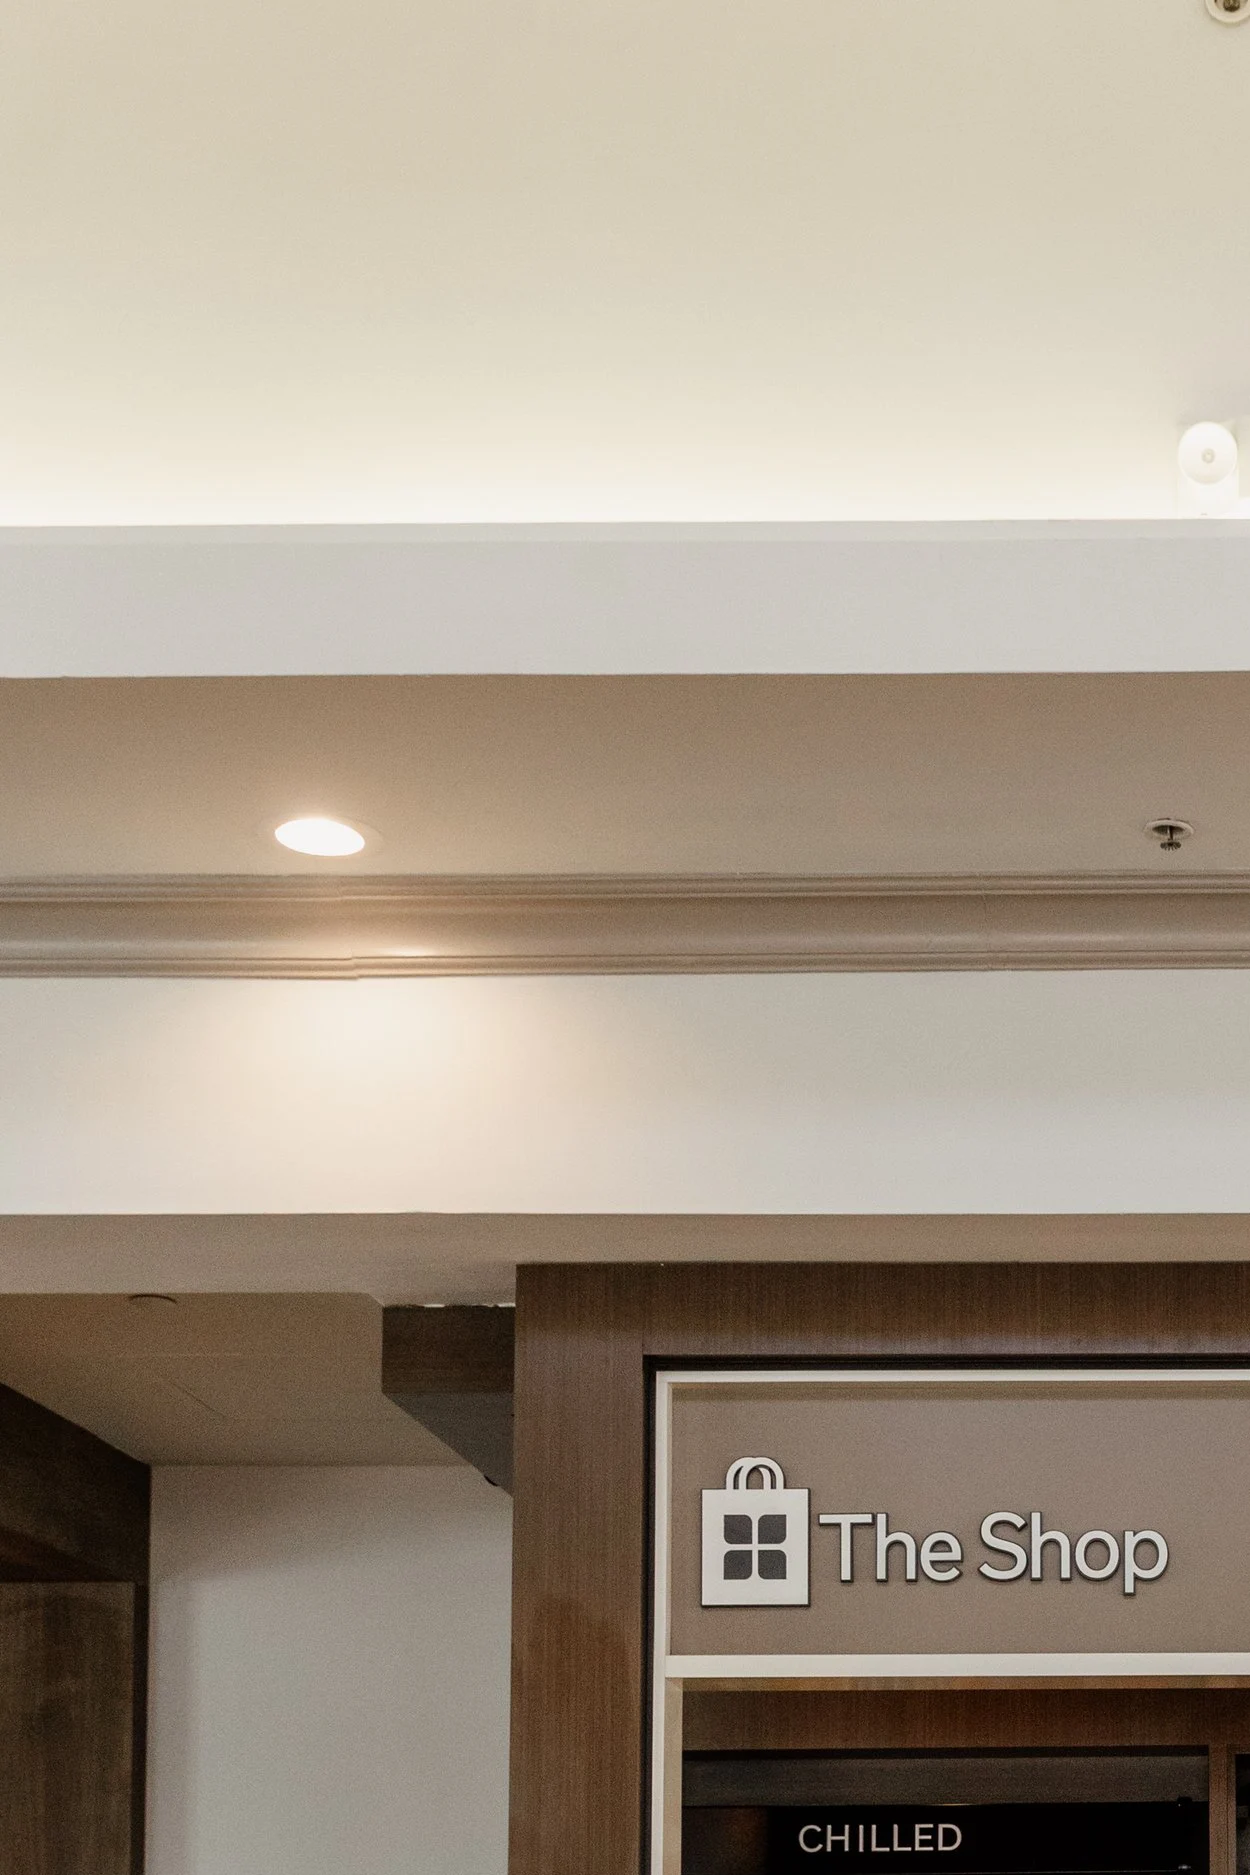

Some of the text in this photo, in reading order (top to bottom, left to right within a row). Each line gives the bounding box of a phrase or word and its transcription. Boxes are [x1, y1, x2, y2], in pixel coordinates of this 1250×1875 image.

[818, 1511, 1170, 1596] The Shop
[798, 1823, 963, 1853] CHILLED
